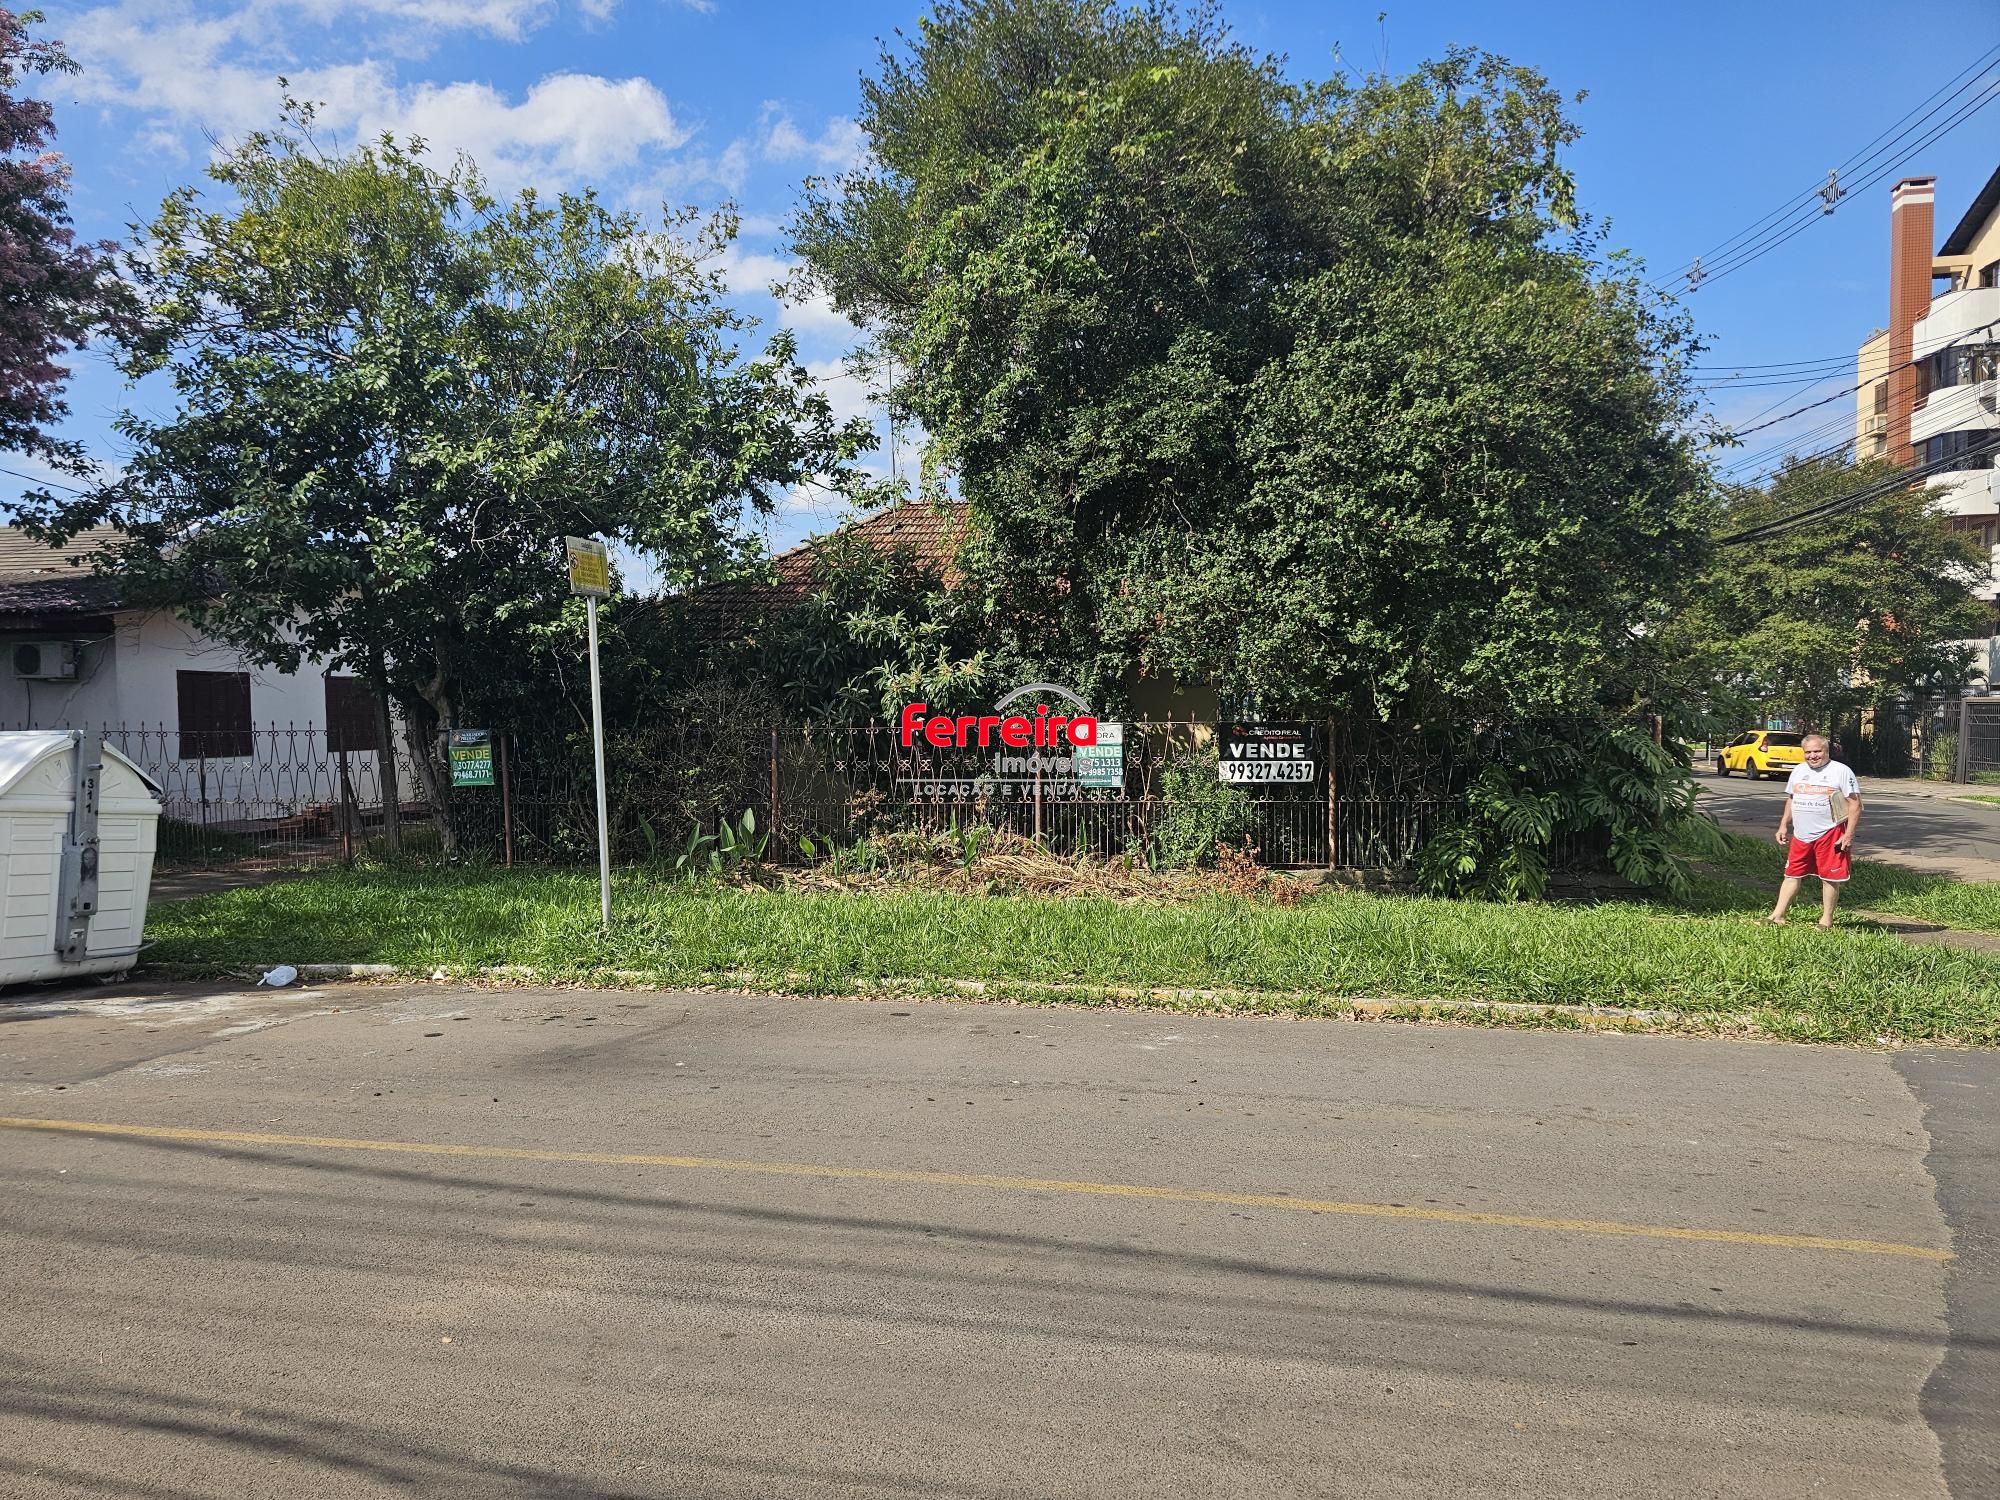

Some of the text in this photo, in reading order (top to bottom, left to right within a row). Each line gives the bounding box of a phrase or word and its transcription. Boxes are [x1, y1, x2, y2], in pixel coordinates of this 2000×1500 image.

[452, 749, 489, 760] VENDE
[1080, 747, 1121, 757] VENDE
[1229, 743, 1305, 758] VENDE
[458, 761, 491, 770] 3077.4277
[1106, 768, 1124, 776] 7358
[1229, 763, 1312, 780] 99327.4257
[86, 778, 95, 813] 311
